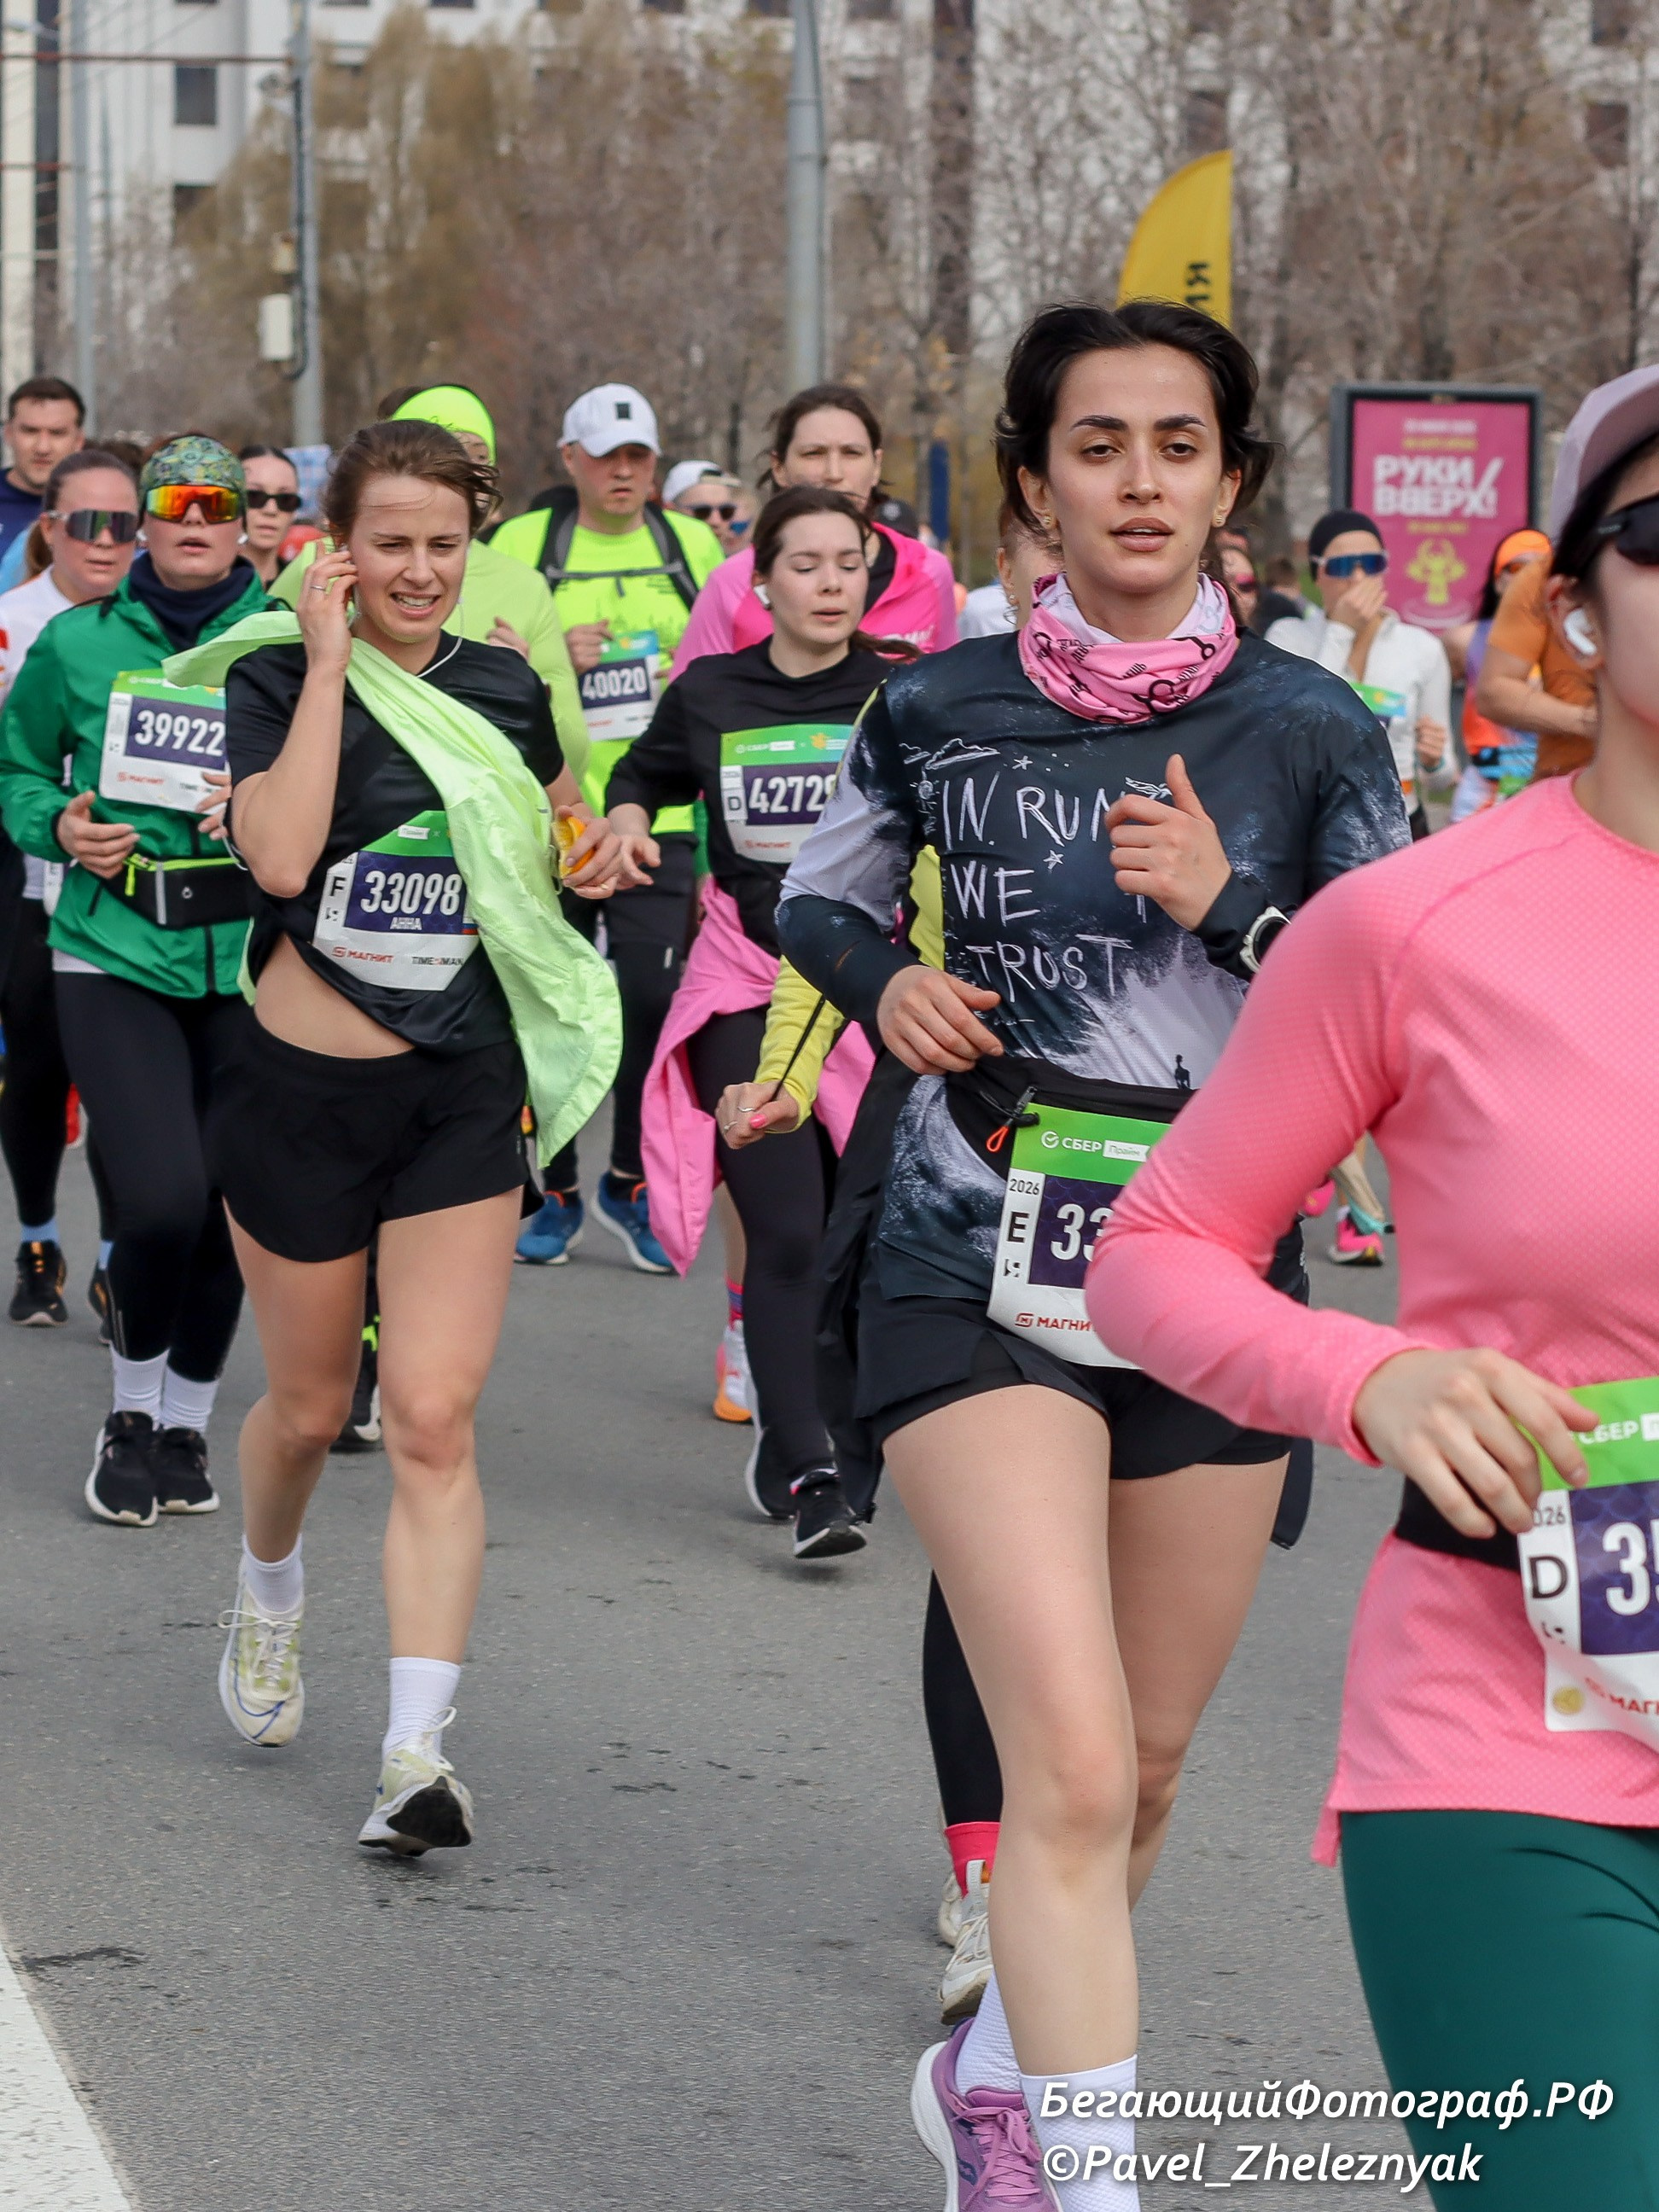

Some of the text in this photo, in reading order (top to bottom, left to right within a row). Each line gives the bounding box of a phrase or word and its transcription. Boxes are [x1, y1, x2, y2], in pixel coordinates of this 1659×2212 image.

[1374, 455, 1475, 485] РУКИ
[582, 667, 648, 700] 40020
[134, 709, 226, 757] 39922
[728, 795, 742, 812] D
[330, 876, 346, 897] F
[360, 870, 463, 916] 33098
[950, 859, 1041, 927] WE
[964, 934, 1134, 1003] TRUST
[1062, 1137, 1103, 1153] СБЕР
[1009, 1178, 1040, 1196] 2026
[1008, 1211, 1029, 1243] E
[1037, 1316, 1096, 1333] МАГНИ
[1532, 1506, 1566, 1526] 026
[1528, 1556, 1568, 1599] D
